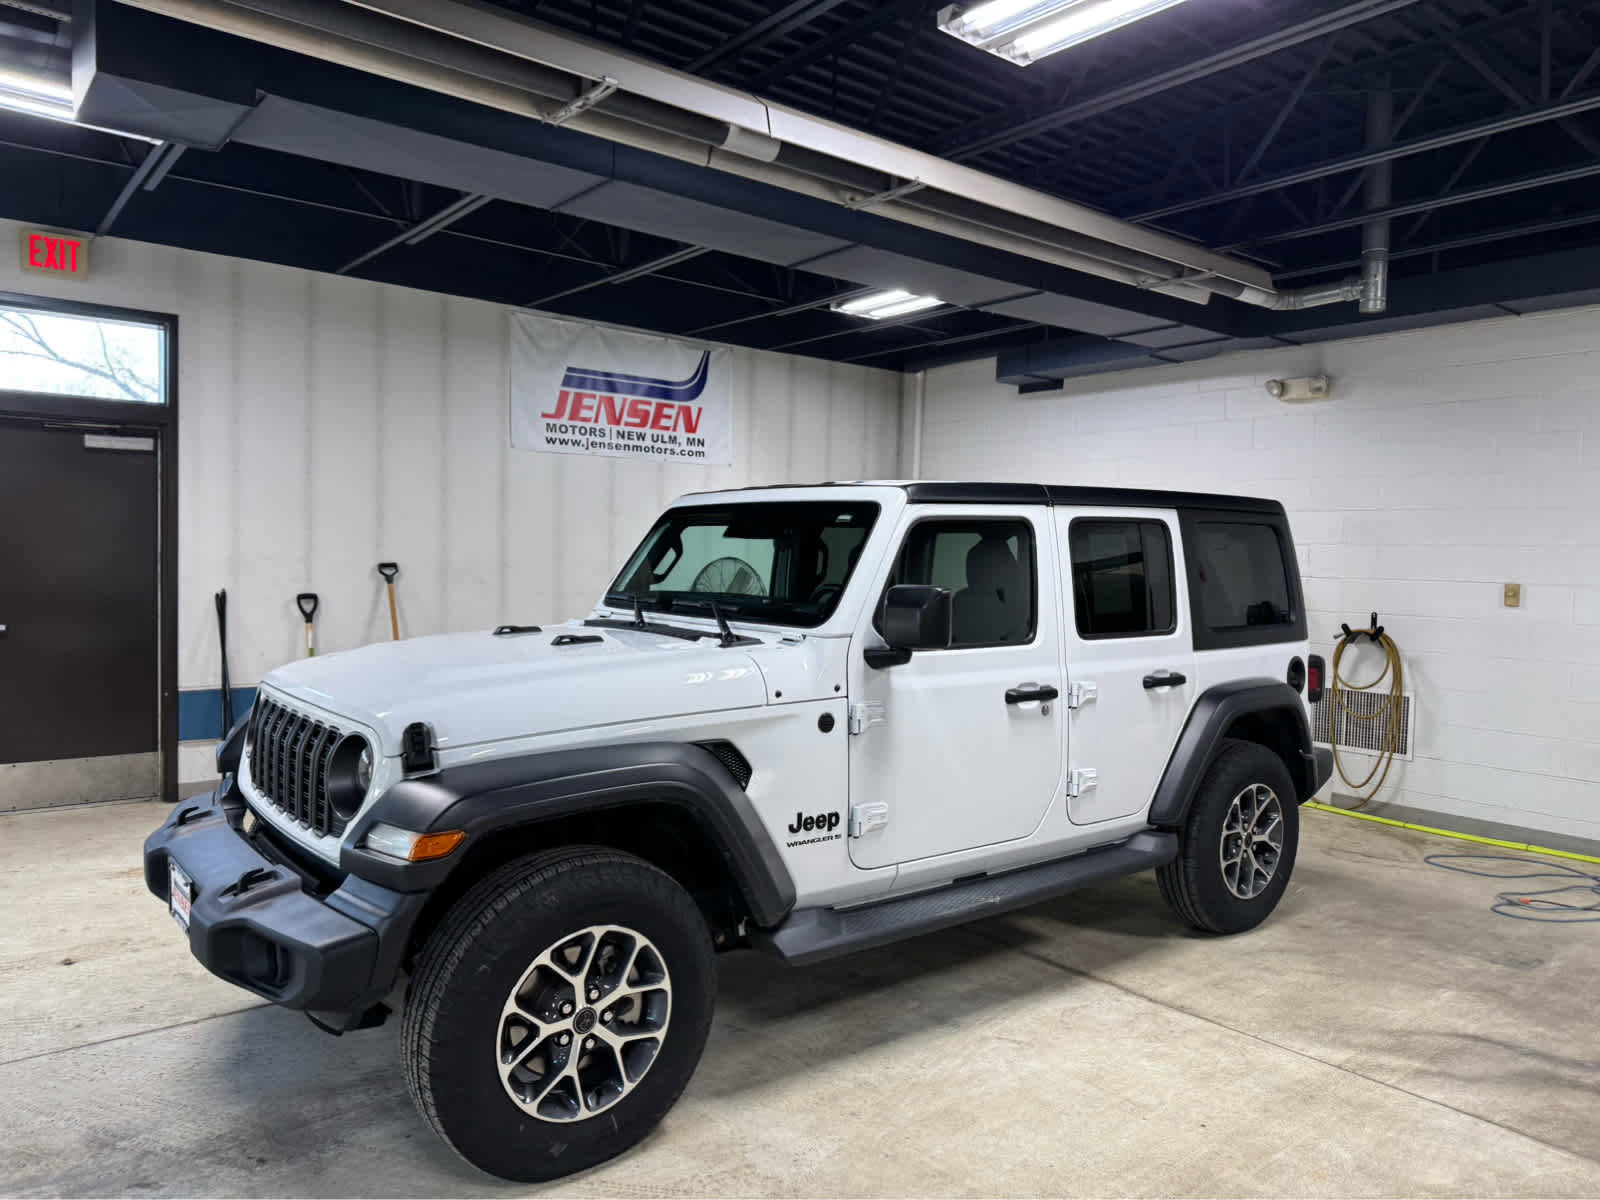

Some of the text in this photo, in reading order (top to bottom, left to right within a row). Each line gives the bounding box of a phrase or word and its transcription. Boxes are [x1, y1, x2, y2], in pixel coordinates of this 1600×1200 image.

[30, 235, 81, 272] EXIT
[541, 390, 703, 434] JENSEN
[545, 436, 705, 458] www.jensenmotors.com
[546, 423, 705, 447] MOTORS NEW ULM, MN
[788, 811, 840, 834] Jeep
